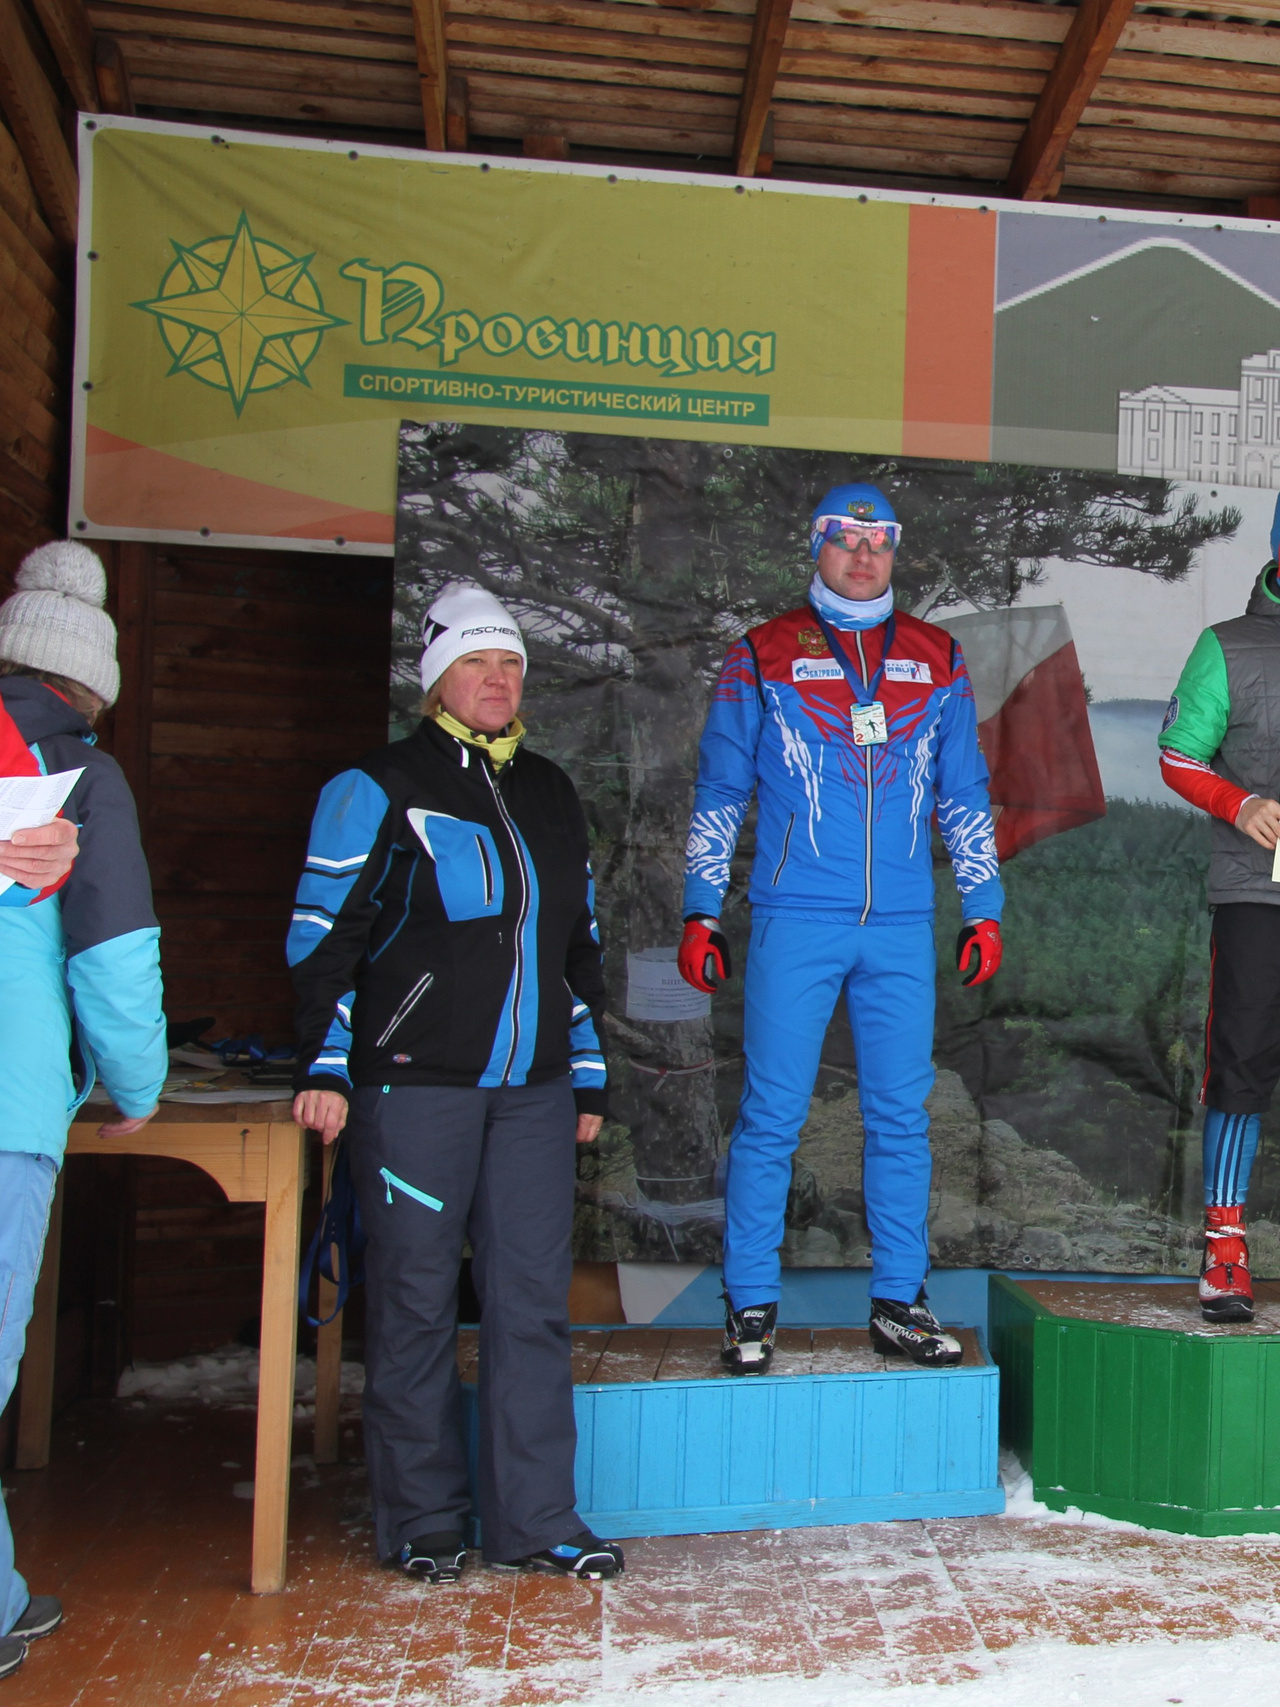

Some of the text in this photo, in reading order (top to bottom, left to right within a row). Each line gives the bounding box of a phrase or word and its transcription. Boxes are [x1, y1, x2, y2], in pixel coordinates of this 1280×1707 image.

[339, 257, 776, 377] Провинция
[359, 374, 756, 418] СПОРТИВНО-ТУРИСТИЧЕСКИЙ ЦЕНТР
[461, 626, 517, 639] FISCHER
[810, 668, 842, 678] GAZPROM
[856, 733, 864, 743] 2
[880, 1316, 925, 1344] SALOMON
